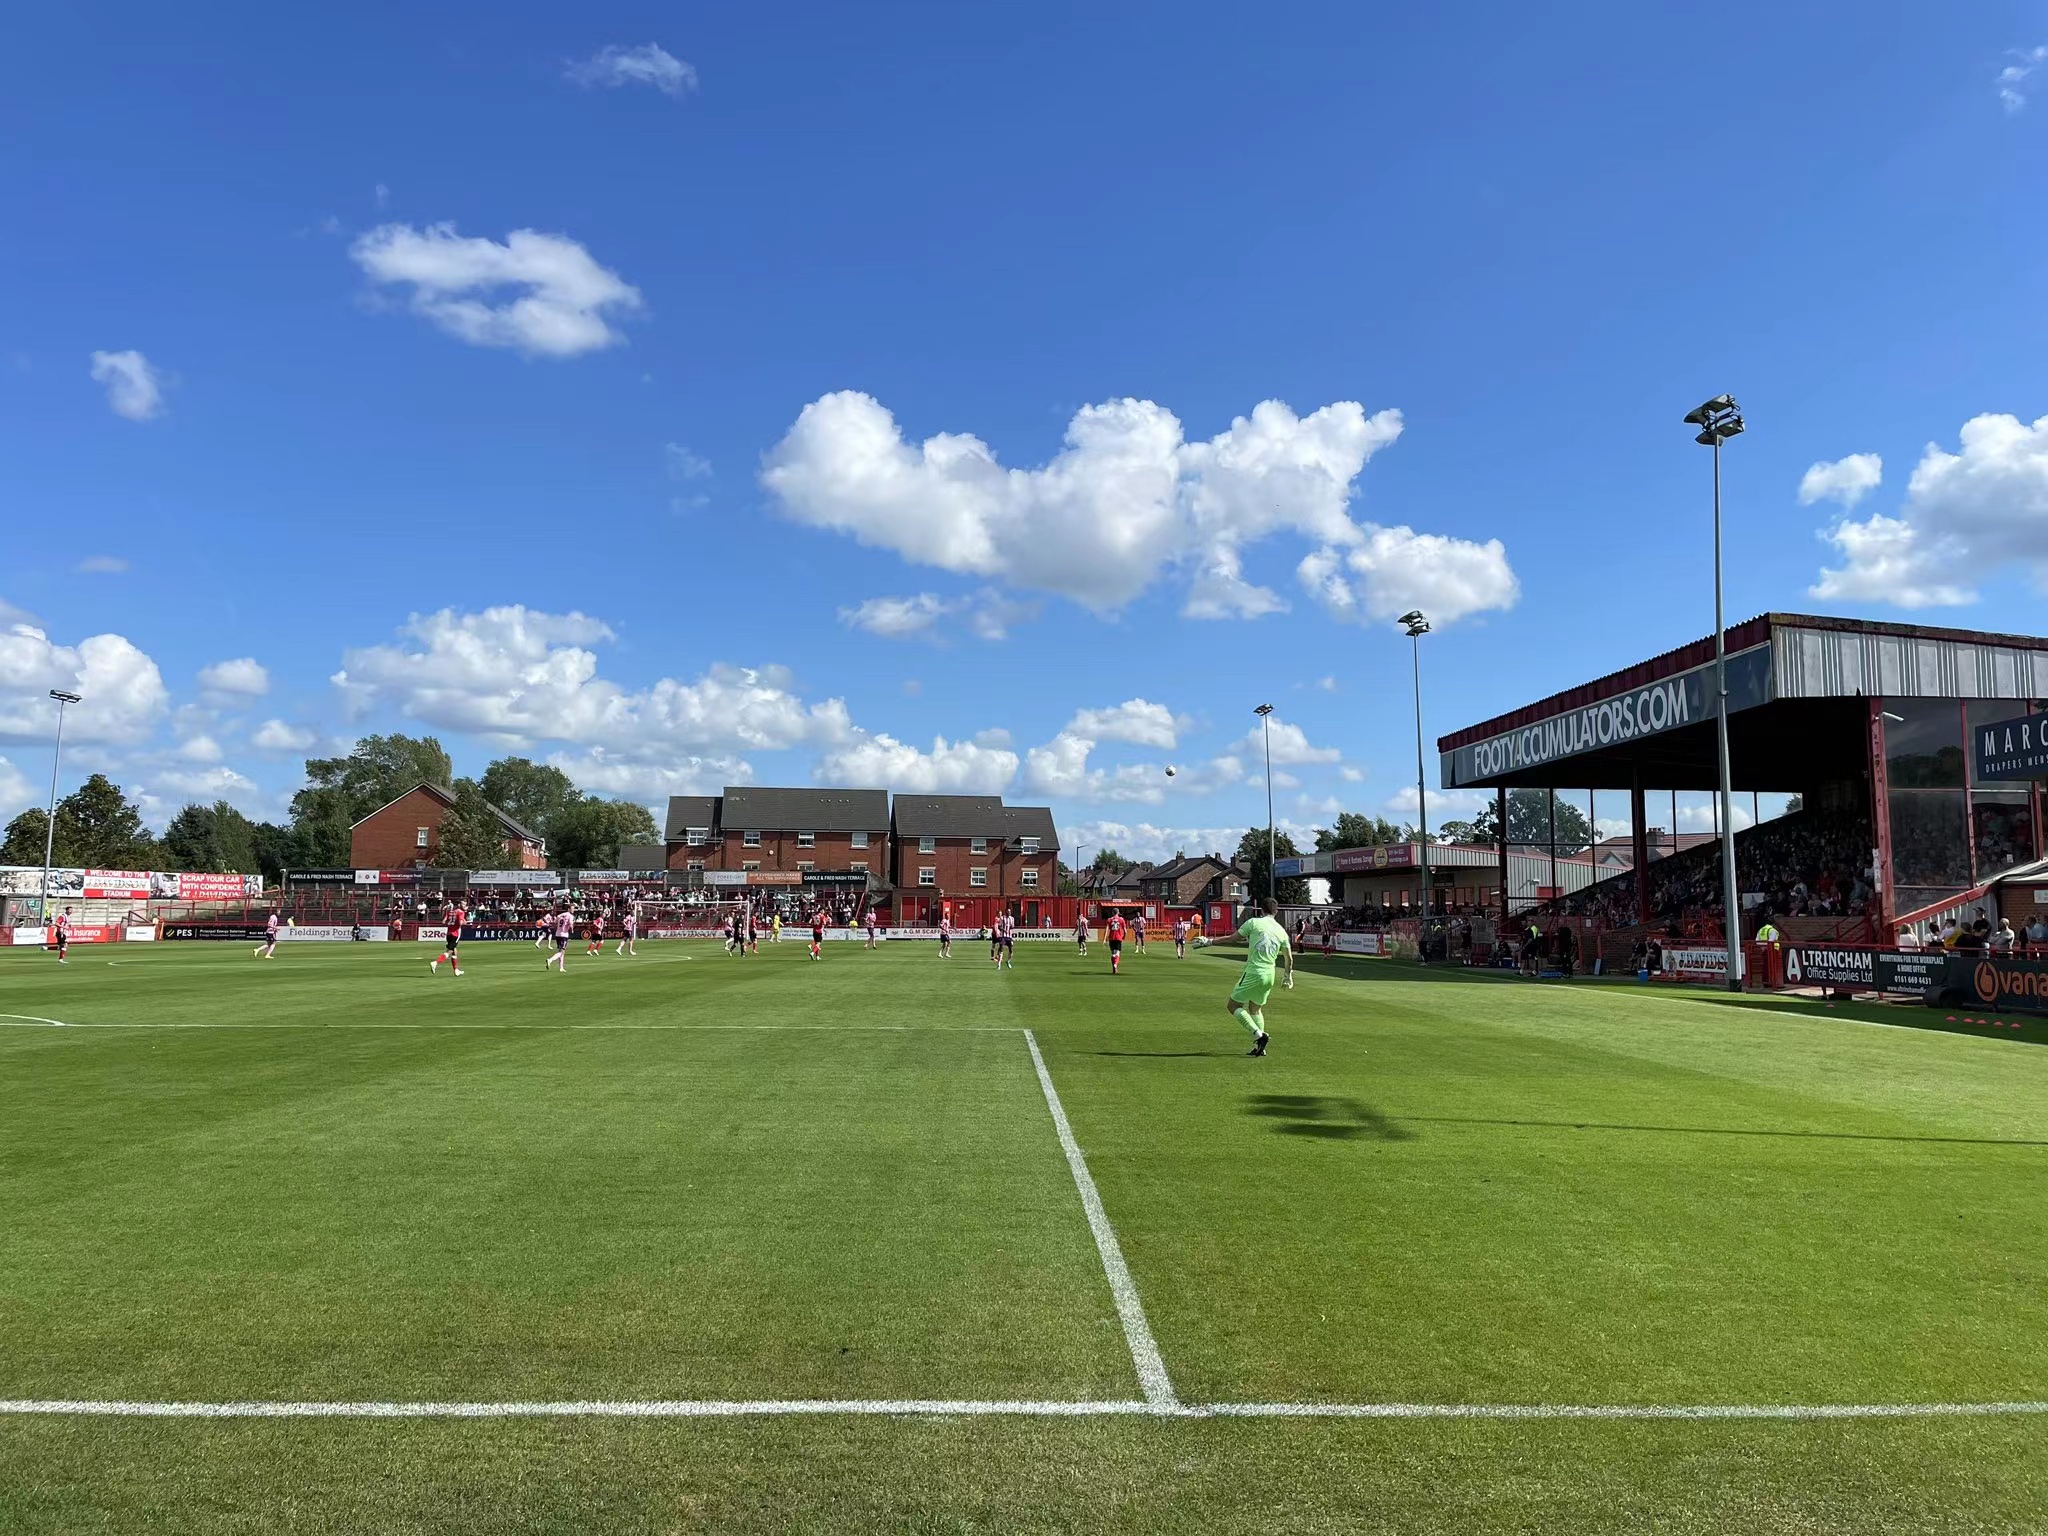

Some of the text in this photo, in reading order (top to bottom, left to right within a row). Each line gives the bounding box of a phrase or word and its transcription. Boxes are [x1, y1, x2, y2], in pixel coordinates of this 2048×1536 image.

[1474, 679, 1689, 777] FOOTYACCUMULATORS.COM
[1985, 720, 2048, 756] MARC
[1986, 758, 2021, 773] DRAPERS
[90, 869, 122, 877] WELCOME
[134, 871, 146, 879] THE
[182, 875, 240, 884] SCRAP YOUR CAR
[182, 882, 242, 891] WITH CONFIDENCE
[176, 929, 192, 937] PES
[289, 928, 352, 937] Fieldings Port
[422, 930, 446, 938] 32Re
[475, 930, 502, 938] MARC
[1012, 931, 1061, 939] obinsons
[1879, 954, 1944, 965] EVERYTHING FOR THE WORKPLACE
[1786, 949, 1873, 982] ALTRINCHAM
[1901, 965, 1912, 973] HOME
[1913, 966, 1927, 974] OFFICE
[1807, 967, 1873, 984] Office Supplies Ltd
[1894, 975, 1907, 983] 0161
